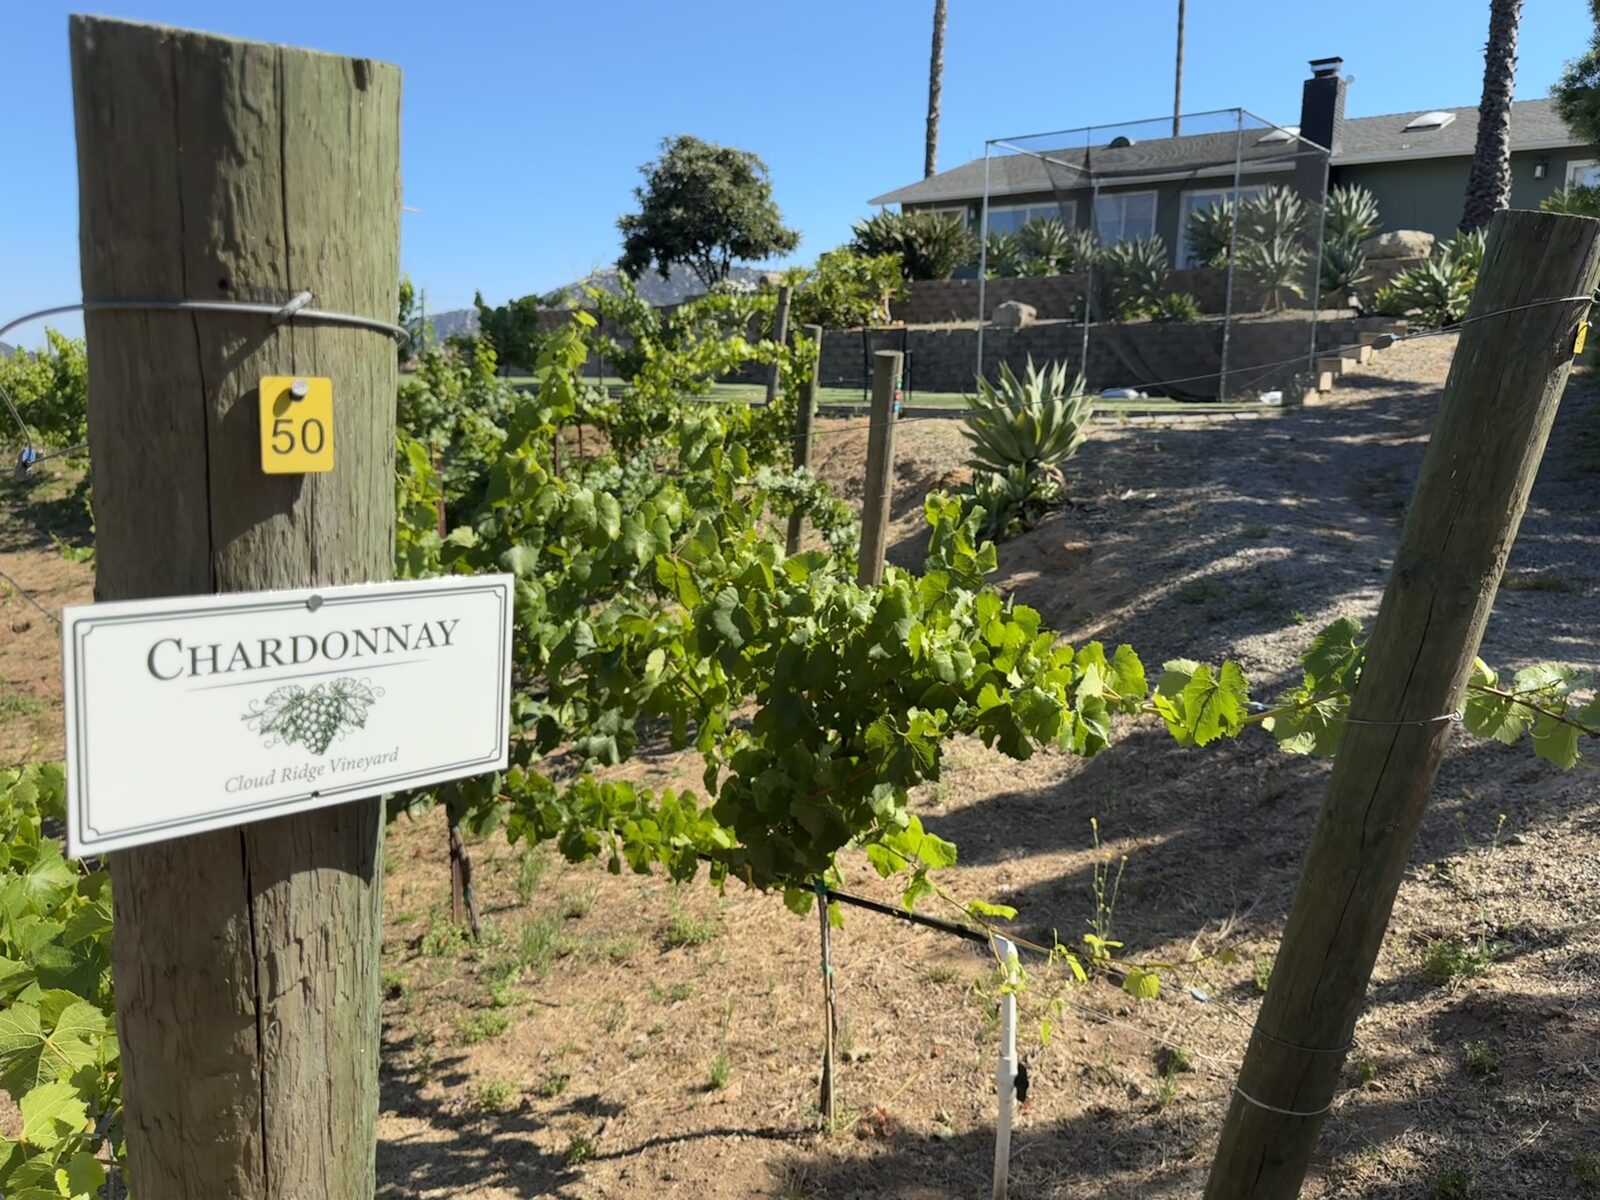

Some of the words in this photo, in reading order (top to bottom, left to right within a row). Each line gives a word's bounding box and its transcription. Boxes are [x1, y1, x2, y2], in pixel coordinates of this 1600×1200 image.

[272, 418, 325, 455] 50
[147, 619, 461, 681] CHARDONNAY
[224, 769, 276, 793] Cloud
[280, 763, 325, 783] Ridge
[329, 746, 400, 773] Vineyard
